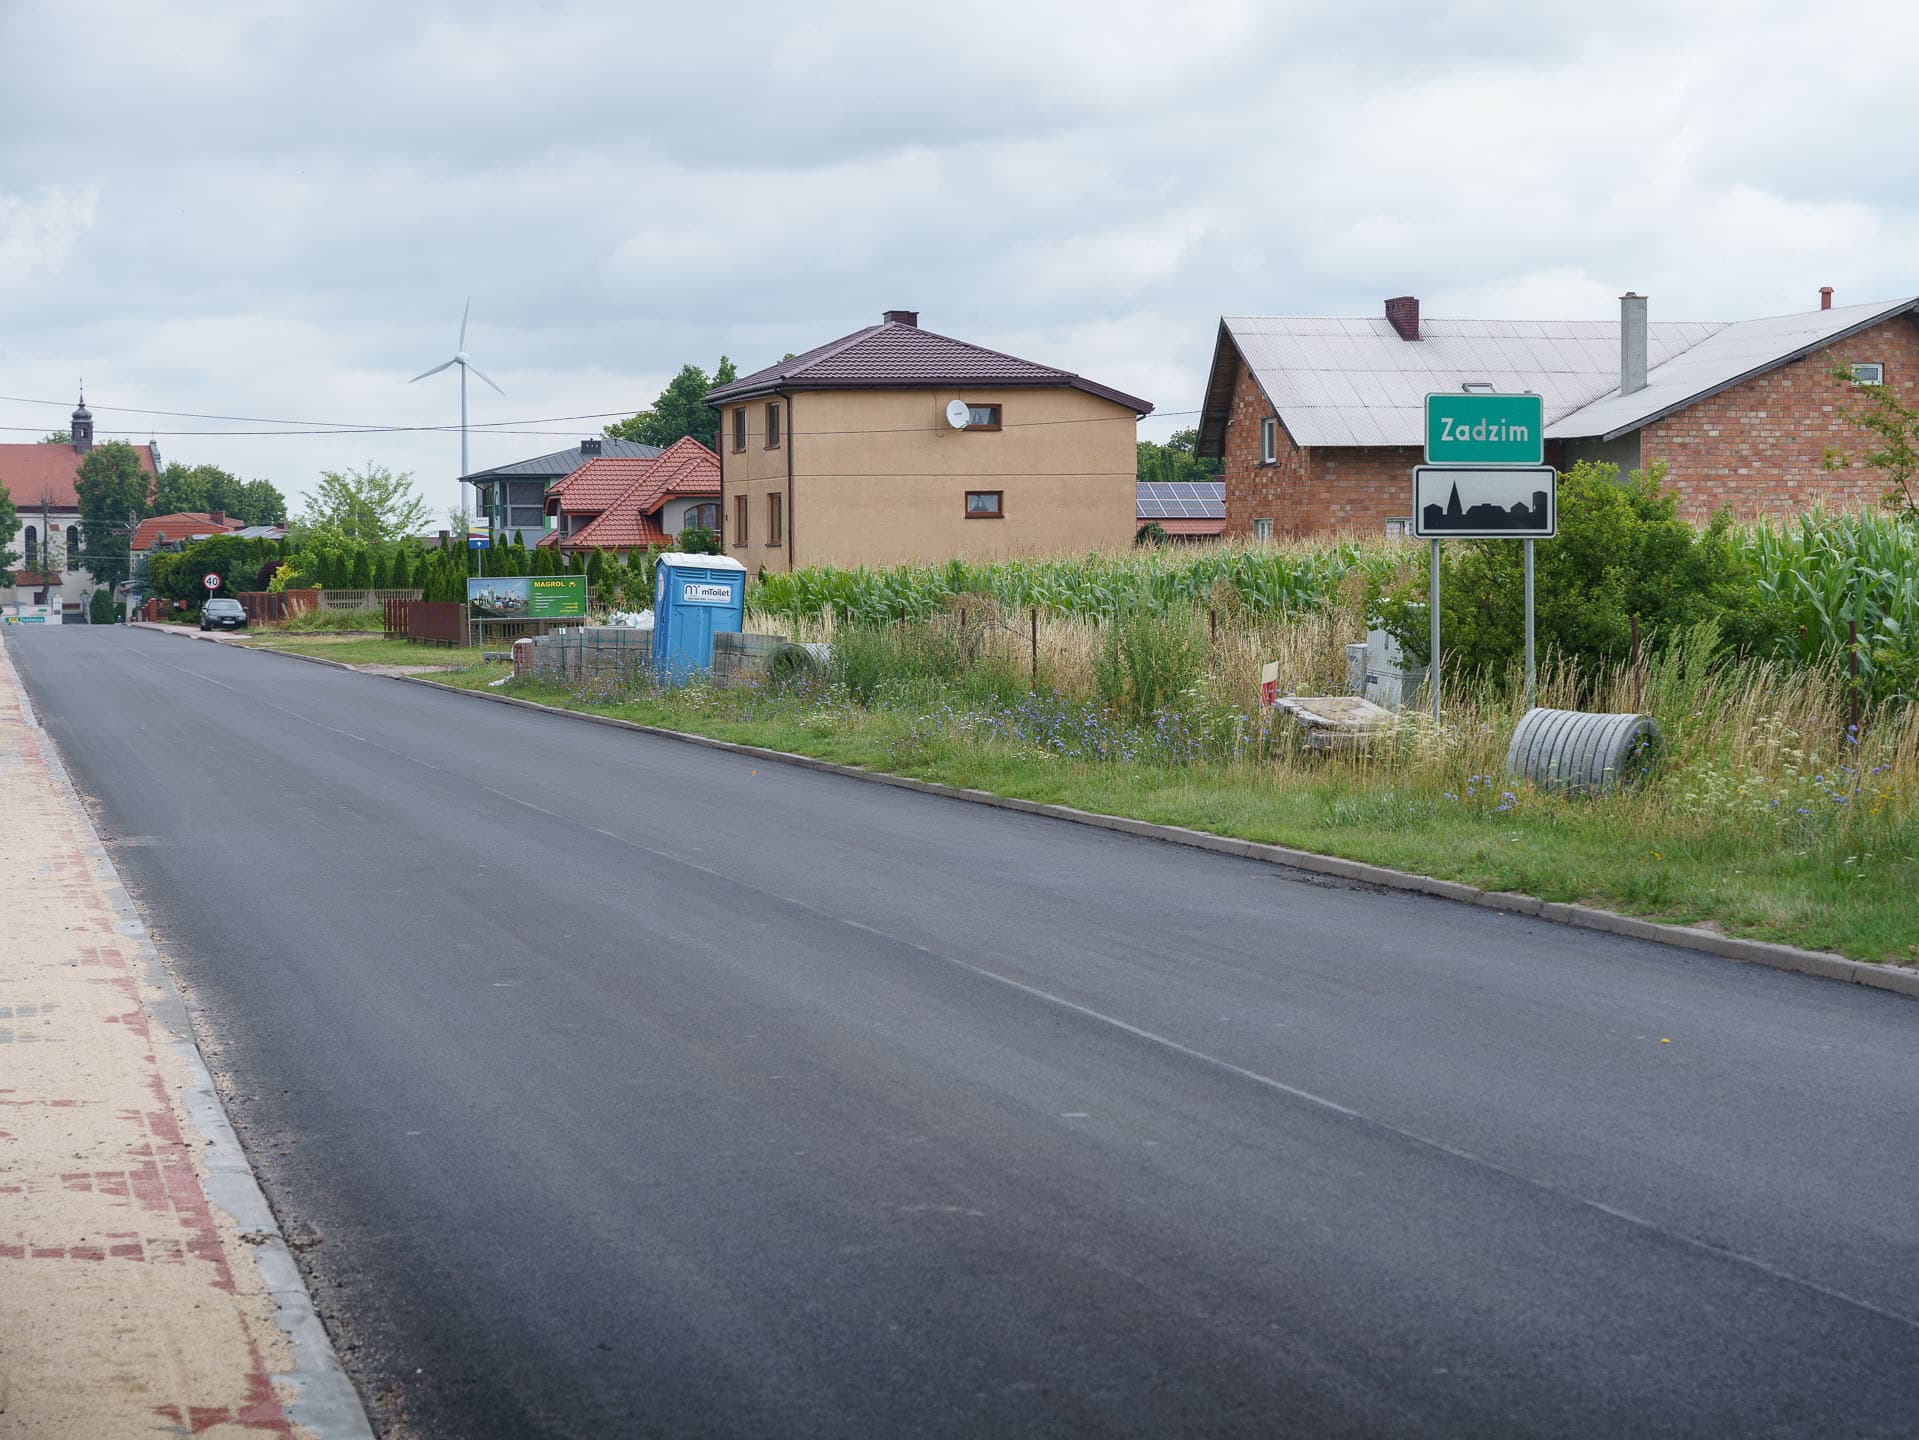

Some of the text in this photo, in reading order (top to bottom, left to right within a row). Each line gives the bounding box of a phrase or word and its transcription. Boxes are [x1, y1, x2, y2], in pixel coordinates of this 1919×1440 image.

[1440, 417, 1529, 442] Zadzim
[206, 577, 218, 586] 40
[701, 588, 730, 597] mToilet
